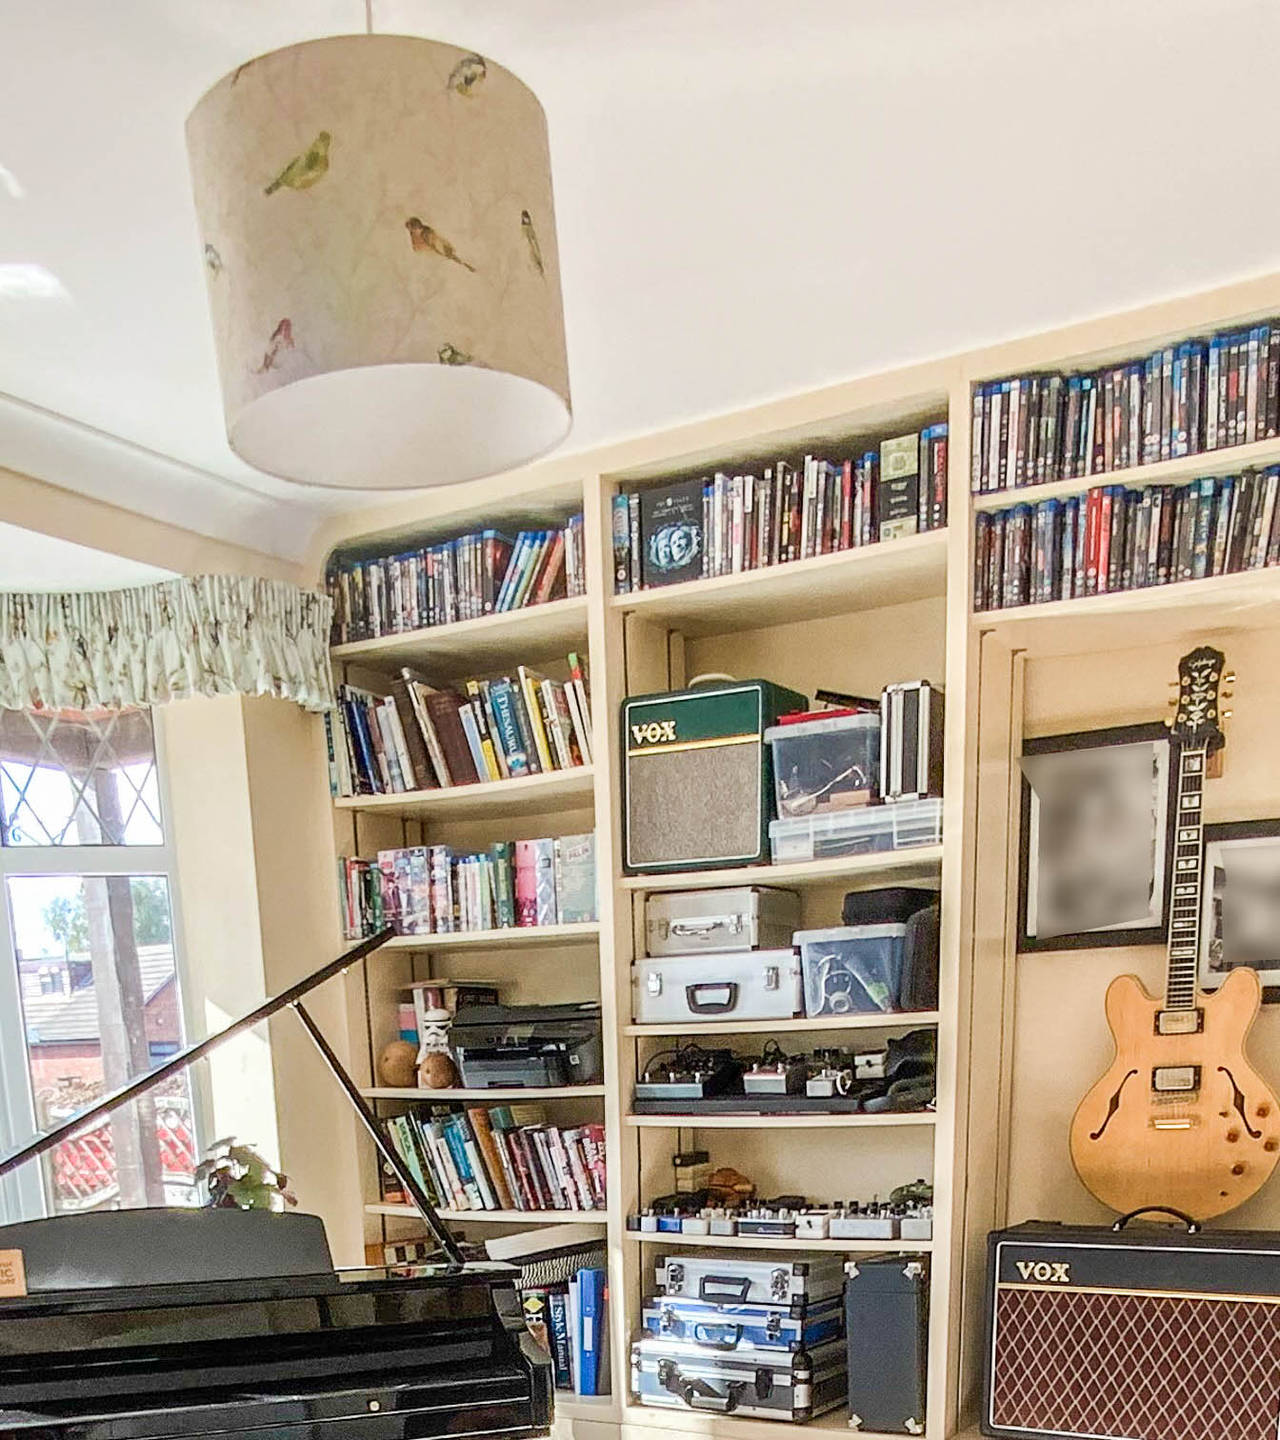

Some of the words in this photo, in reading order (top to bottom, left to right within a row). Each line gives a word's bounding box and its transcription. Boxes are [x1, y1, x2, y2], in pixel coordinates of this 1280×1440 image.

[497, 693, 518, 757] THESAURU
[631, 720, 676, 745] VOX
[1016, 1261, 1070, 1282] VOX
